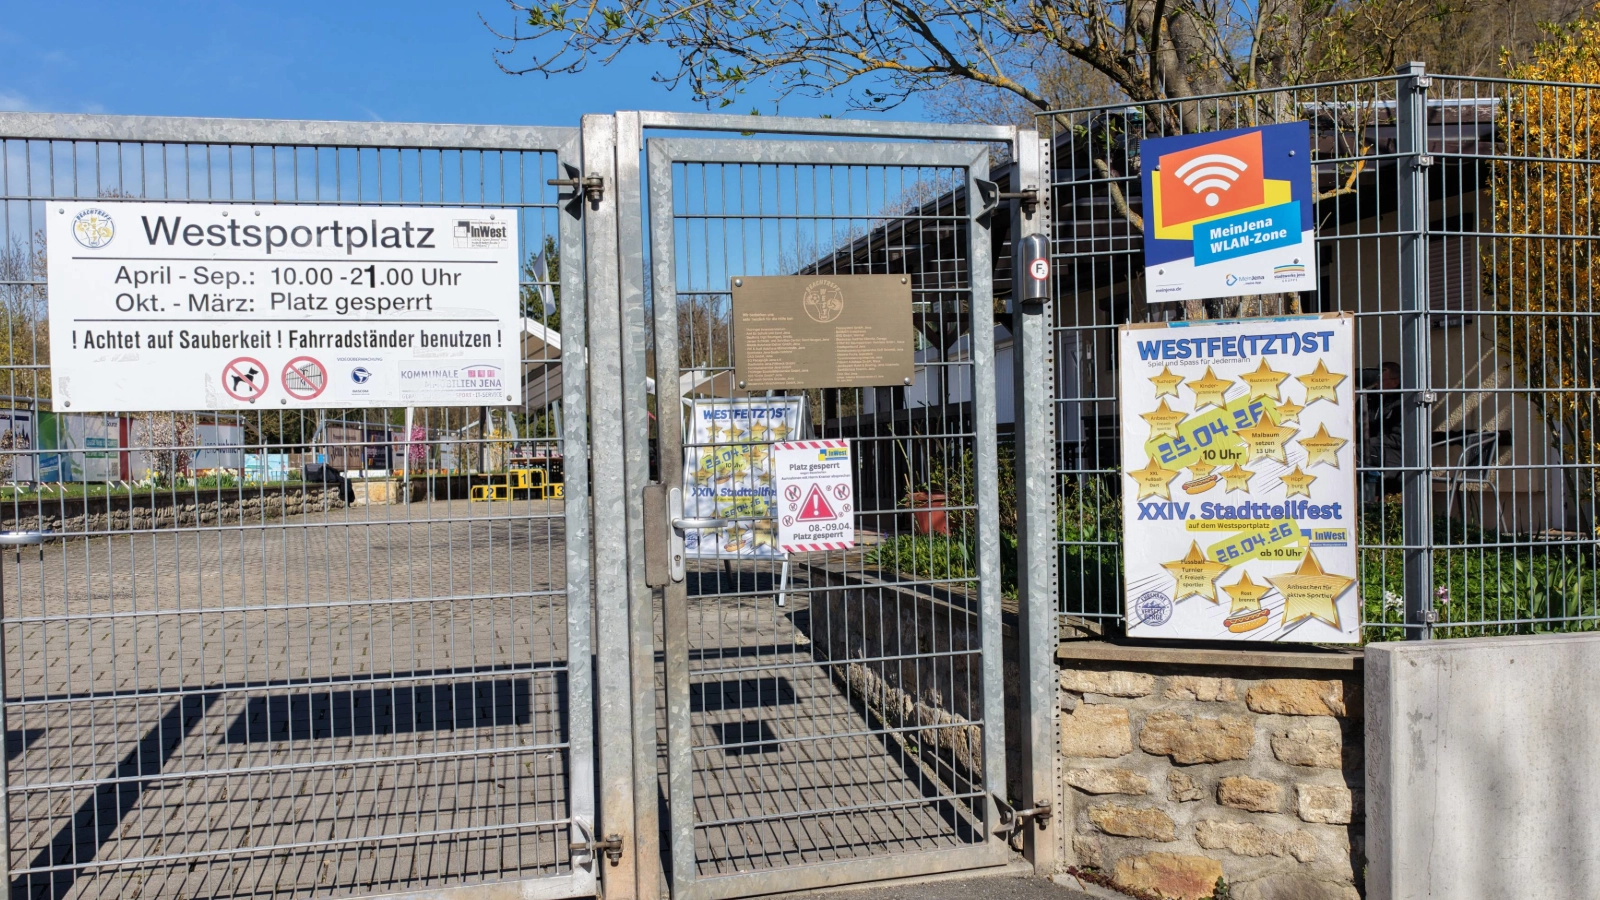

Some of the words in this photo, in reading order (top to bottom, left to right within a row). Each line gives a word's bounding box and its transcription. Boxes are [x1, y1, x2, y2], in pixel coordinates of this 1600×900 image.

[471, 226, 507, 239] InWest
[1209, 217, 1273, 240] MeinJena
[141, 216, 435, 255] Westsportplatz
[1210, 229, 1287, 254] WLAN-Zone
[114, 265, 171, 288] April
[193, 266, 254, 289] Sep.:
[271, 267, 333, 286] 10.00
[422, 268, 461, 286] Uhr
[115, 293, 165, 312] Okt.
[188, 293, 254, 312] März:
[271, 292, 328, 311] Platz
[335, 293, 432, 315] gesperrt
[84, 330, 140, 349] Achtet
[147, 330, 174, 349] auf
[179, 330, 271, 349] Sauberkeit
[289, 330, 415, 348] Fahrradständer
[421, 330, 491, 348] benutzen
[1137, 331, 1334, 360] WESTFE(TZT)ST
[1147, 360, 1164, 368] Spiel
[1179, 359, 1200, 367] Spass
[1212, 356, 1251, 365] Jedermann
[401, 370, 458, 379] KOMMUNALE
[479, 379, 502, 388] JENA
[1202, 449, 1216, 460] 10
[1219, 449, 1242, 460] Uhr
[789, 463, 808, 471] Platz
[809, 462, 840, 471] gesperrt
[521, 473, 526, 485] 1
[486, 487, 494, 499] 2
[556, 485, 564, 497] 3
[1137, 501, 1196, 520] XXIV.
[1200, 500, 1343, 520] Stadtteilfest
[1217, 522, 1270, 530] Westsportplatz
[793, 532, 811, 540] Platz
[812, 531, 843, 540] gesperrt
[1315, 531, 1346, 541] InWest
[1216, 522, 1293, 563] 26.04.26
[1260, 549, 1272, 557] ab
[1274, 549, 1284, 557] 10
[1286, 549, 1303, 557] Uhr
